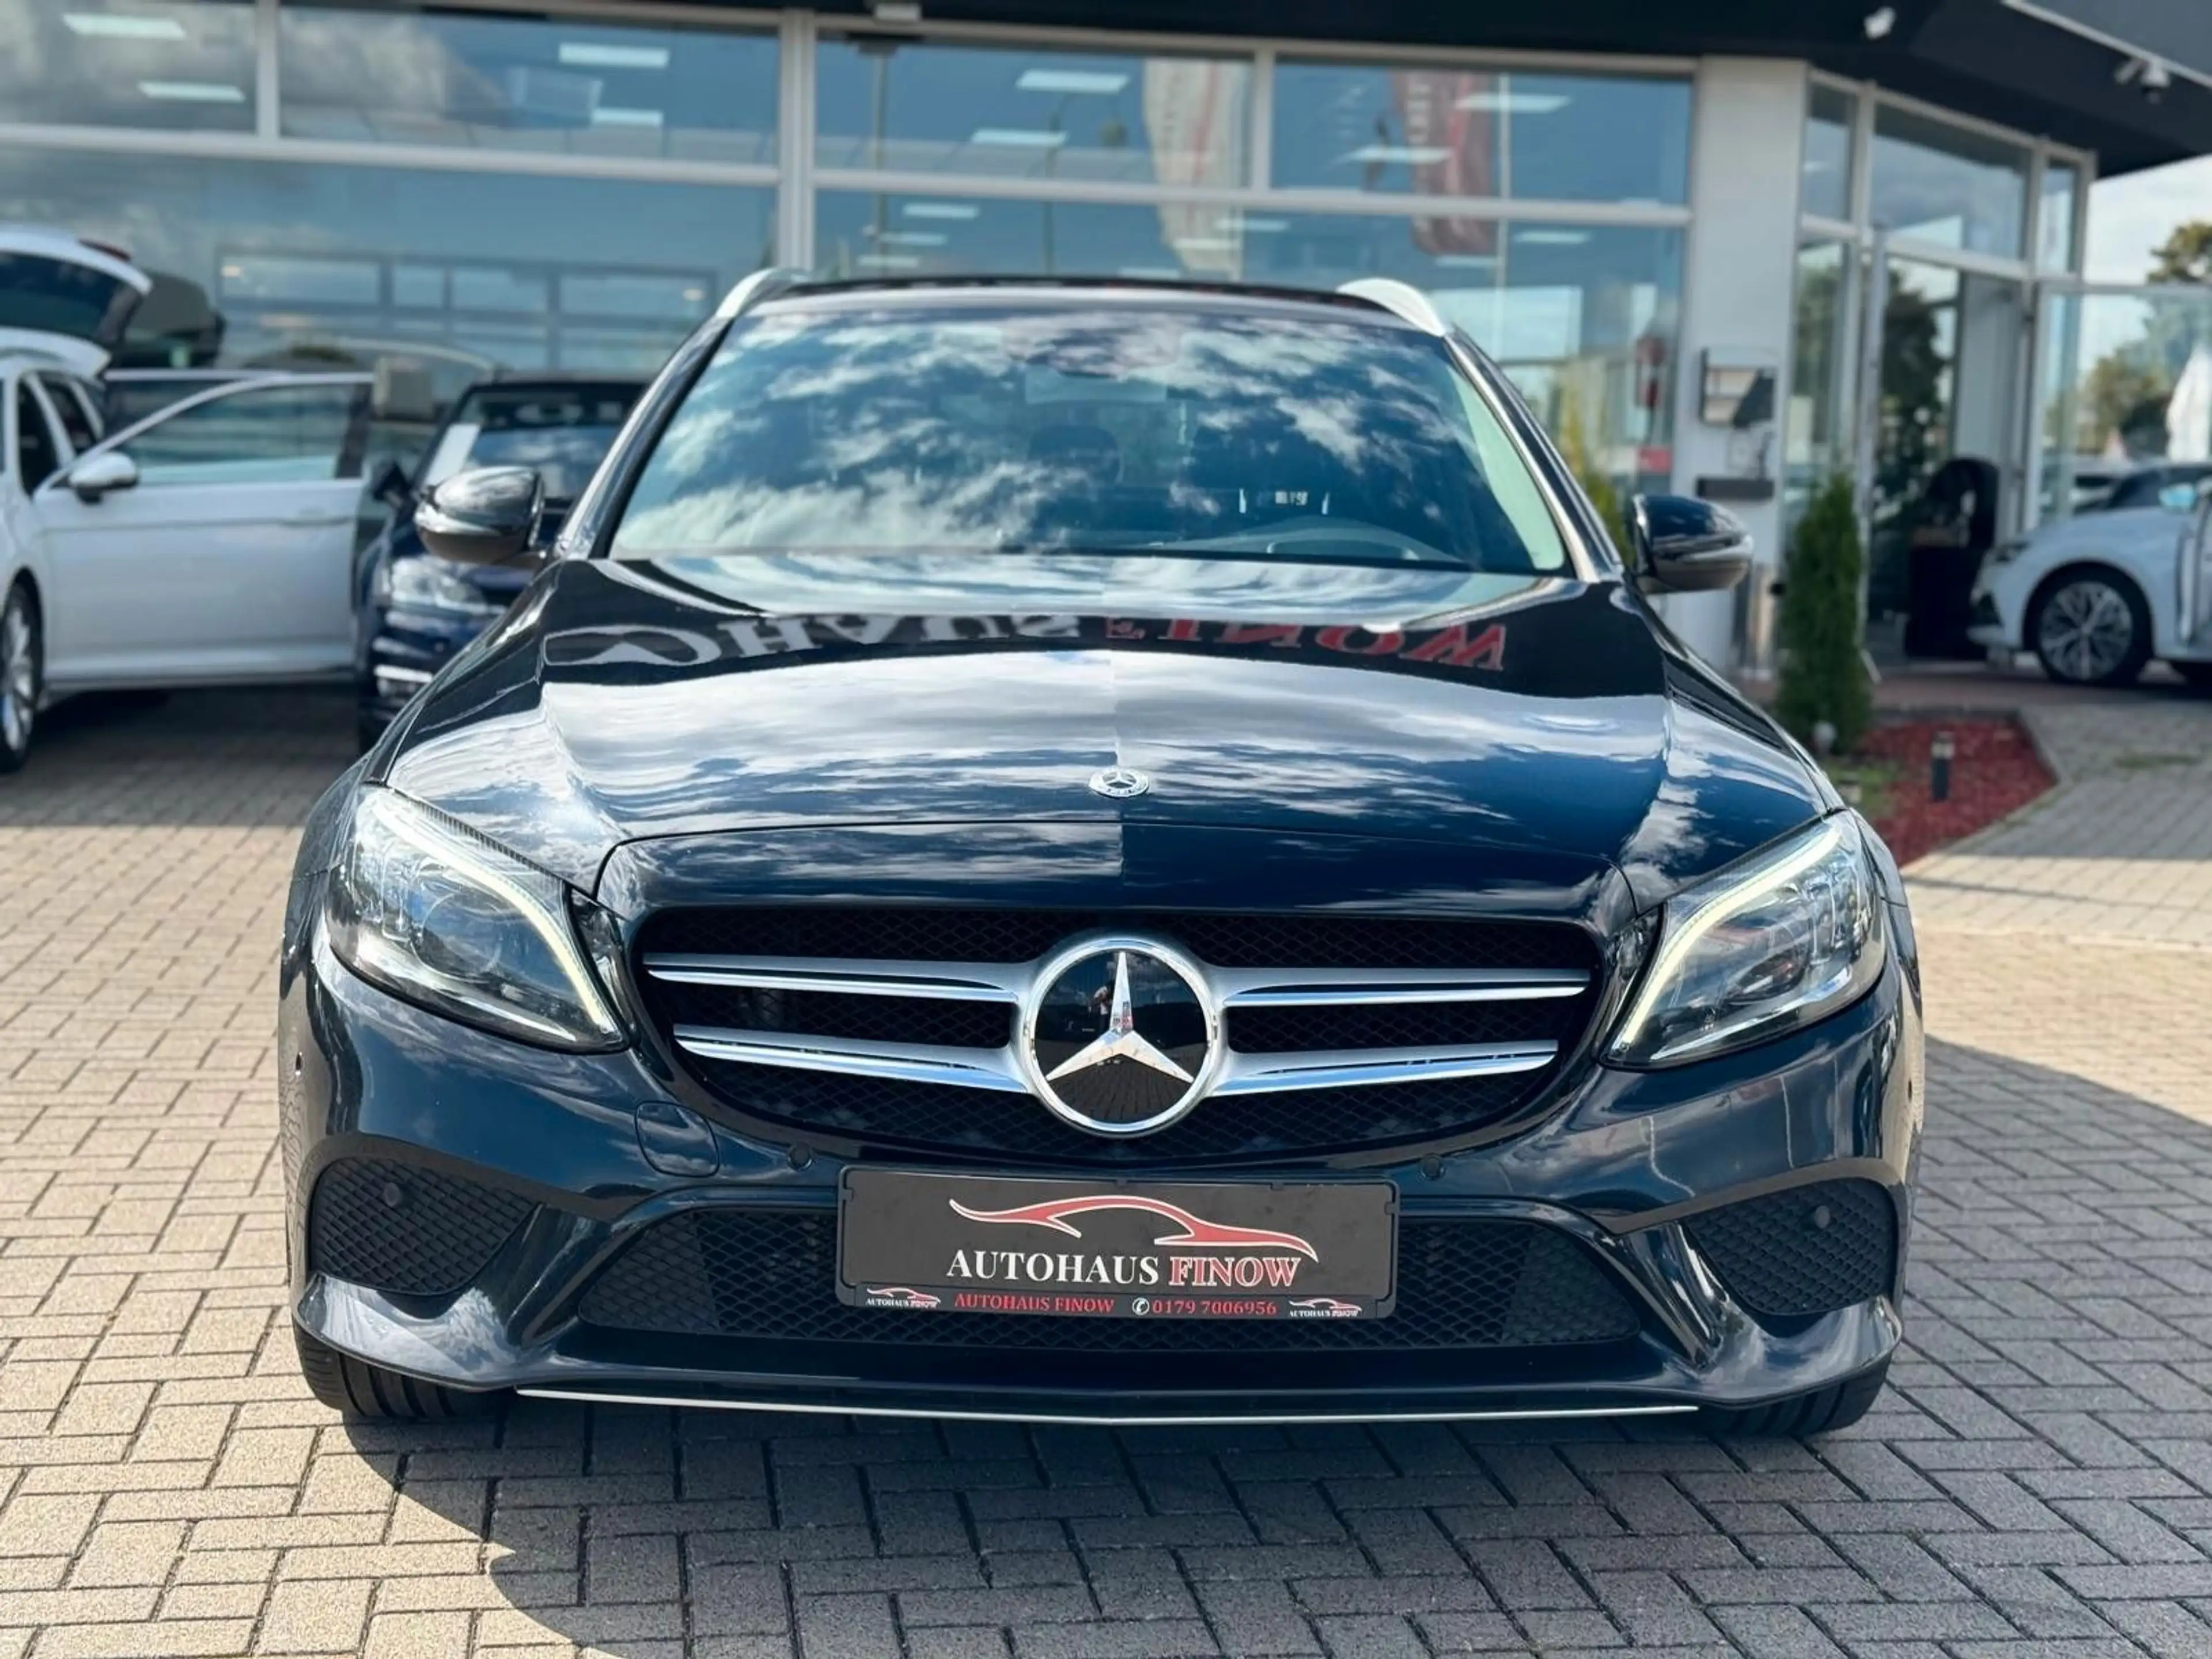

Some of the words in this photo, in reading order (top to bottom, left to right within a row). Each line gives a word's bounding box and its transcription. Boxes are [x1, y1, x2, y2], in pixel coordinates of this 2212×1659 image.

[946, 1249, 1159, 1285] AUTOHAUS
[1169, 1256, 1301, 1287] FINOW
[955, 1293, 1050, 1310] AUTOHAUS
[1055, 1297, 1114, 1312] FINOW
[1153, 1300, 1195, 1314] 0179
[1202, 1300, 1277, 1316] 7006956
